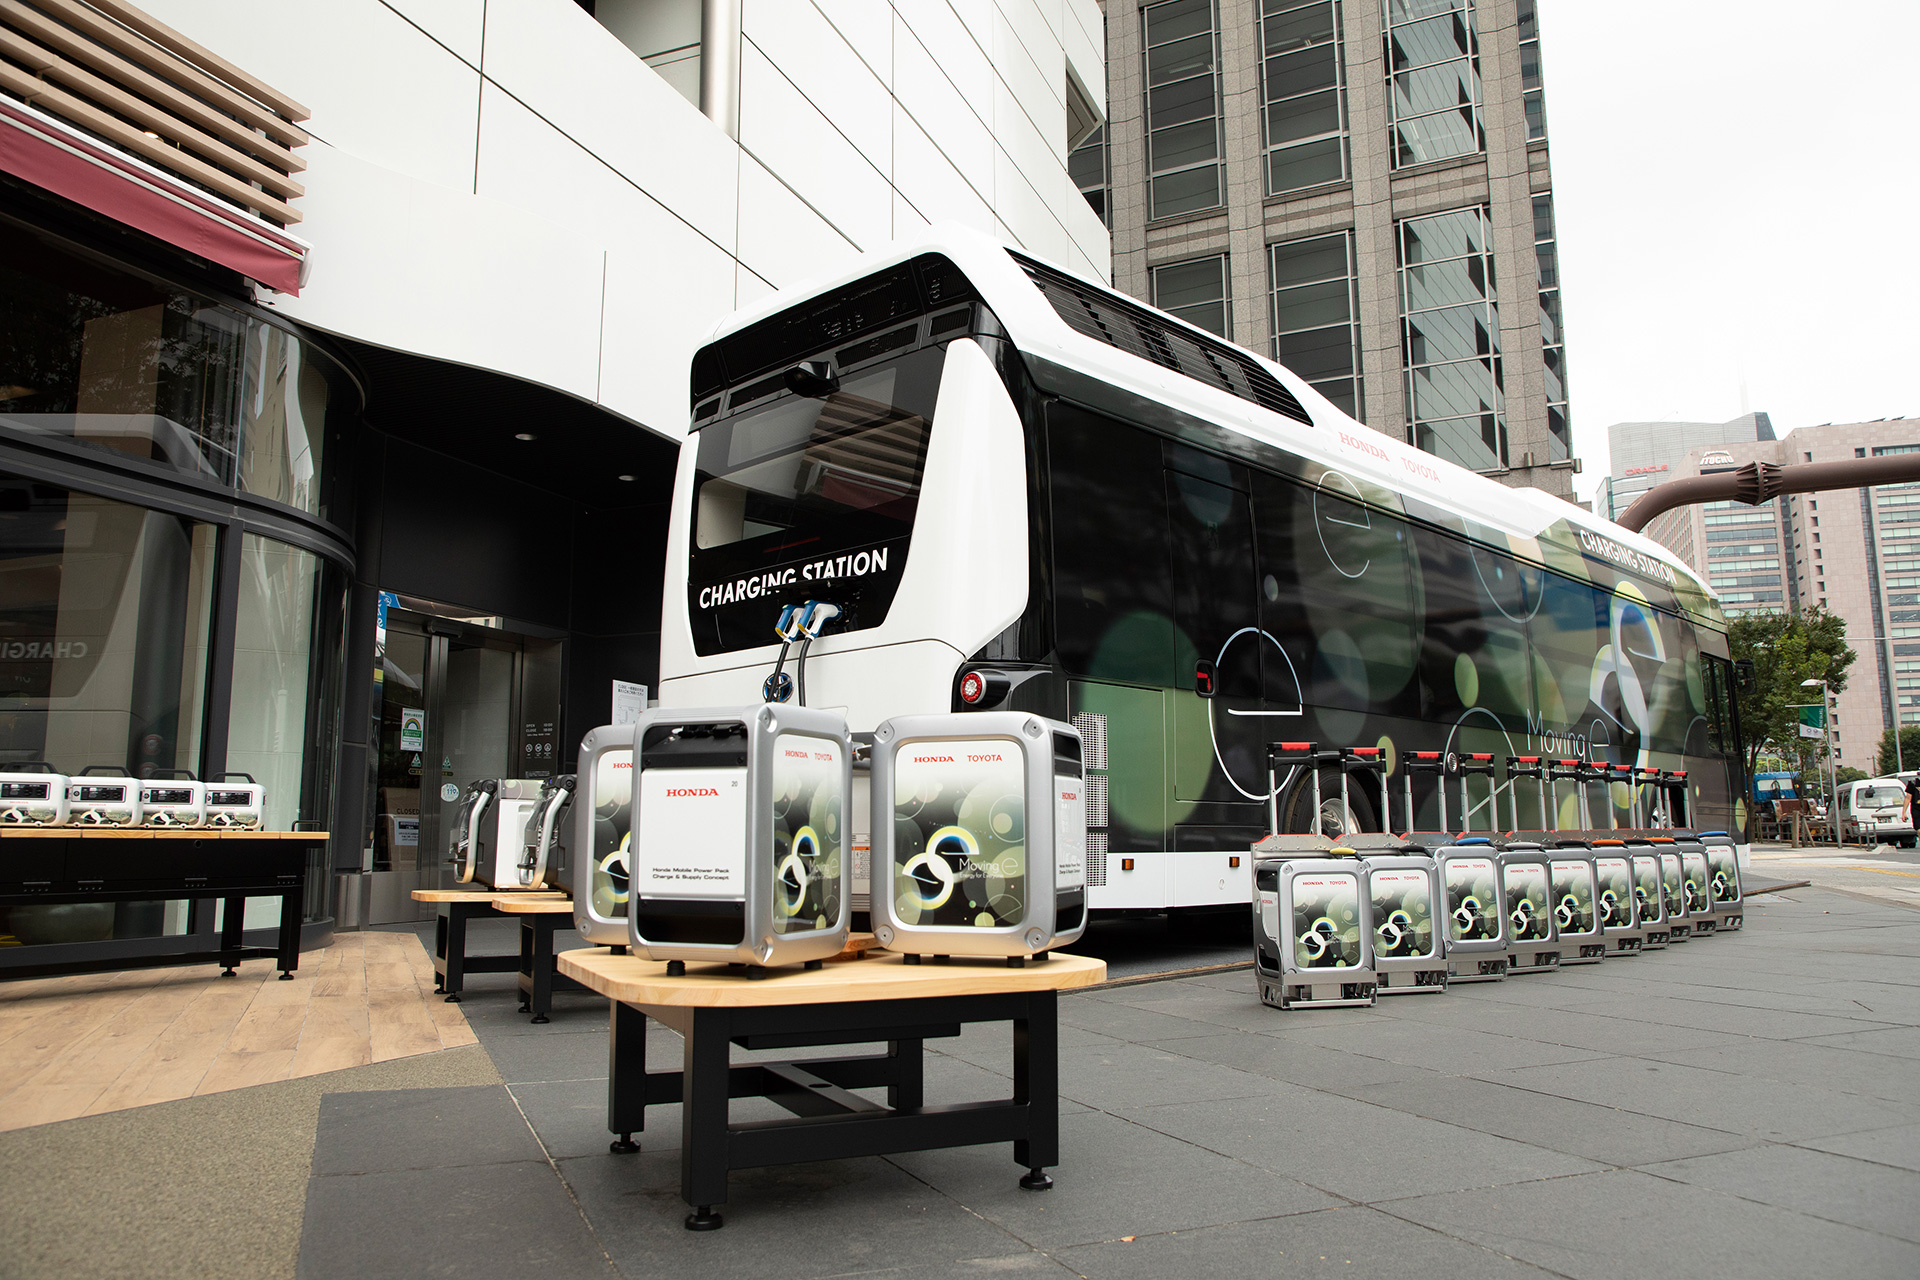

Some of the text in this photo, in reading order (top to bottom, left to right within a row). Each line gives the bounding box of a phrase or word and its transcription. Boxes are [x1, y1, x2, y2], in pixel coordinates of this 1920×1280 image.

[1338, 431, 1441, 484] HONDA TOYOTA
[1699, 455, 1735, 466] ITOCHU
[1624, 464, 1668, 476] ORACLE
[1580, 529, 1678, 585] CHARGING STATION
[699, 546, 888, 609] CHARGING STATION
[1526, 708, 1587, 764] Moving
[785, 749, 833, 762] HONDA TOYOTA
[967, 754, 1003, 762] TOYOTA
[666, 788, 720, 797] HONDA
[1061, 791, 1077, 800] HONDA
[959, 857, 1019, 876] Moving e
